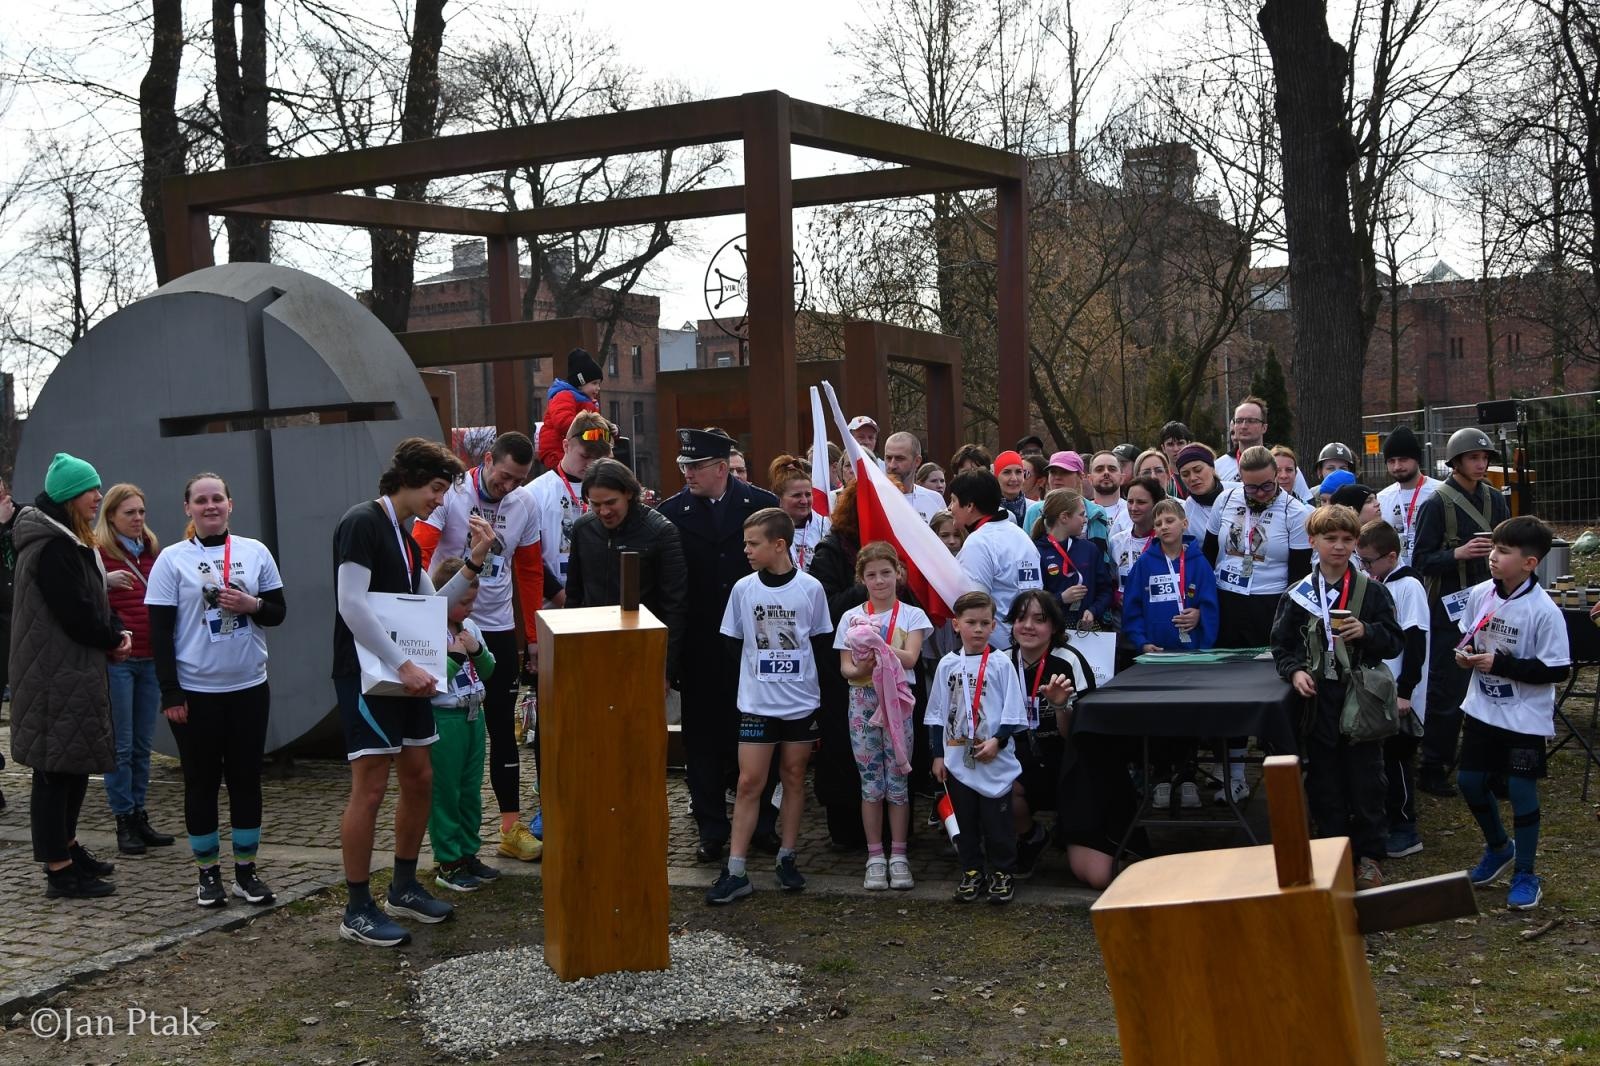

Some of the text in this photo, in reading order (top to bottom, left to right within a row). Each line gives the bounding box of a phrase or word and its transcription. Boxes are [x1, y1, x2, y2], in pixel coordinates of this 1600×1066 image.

[1023, 569, 1034, 581] 72
[1227, 573, 1240, 585] 64
[1157, 583, 1173, 595] 36
[767, 610, 796, 618] WILCZYM
[1490, 622, 1519, 636] WILCZYM
[399, 639, 431, 648] INSTYTUT
[402, 647, 438, 657] TERATURY
[769, 660, 794, 673] 129
[1485, 685, 1502, 697] 54
